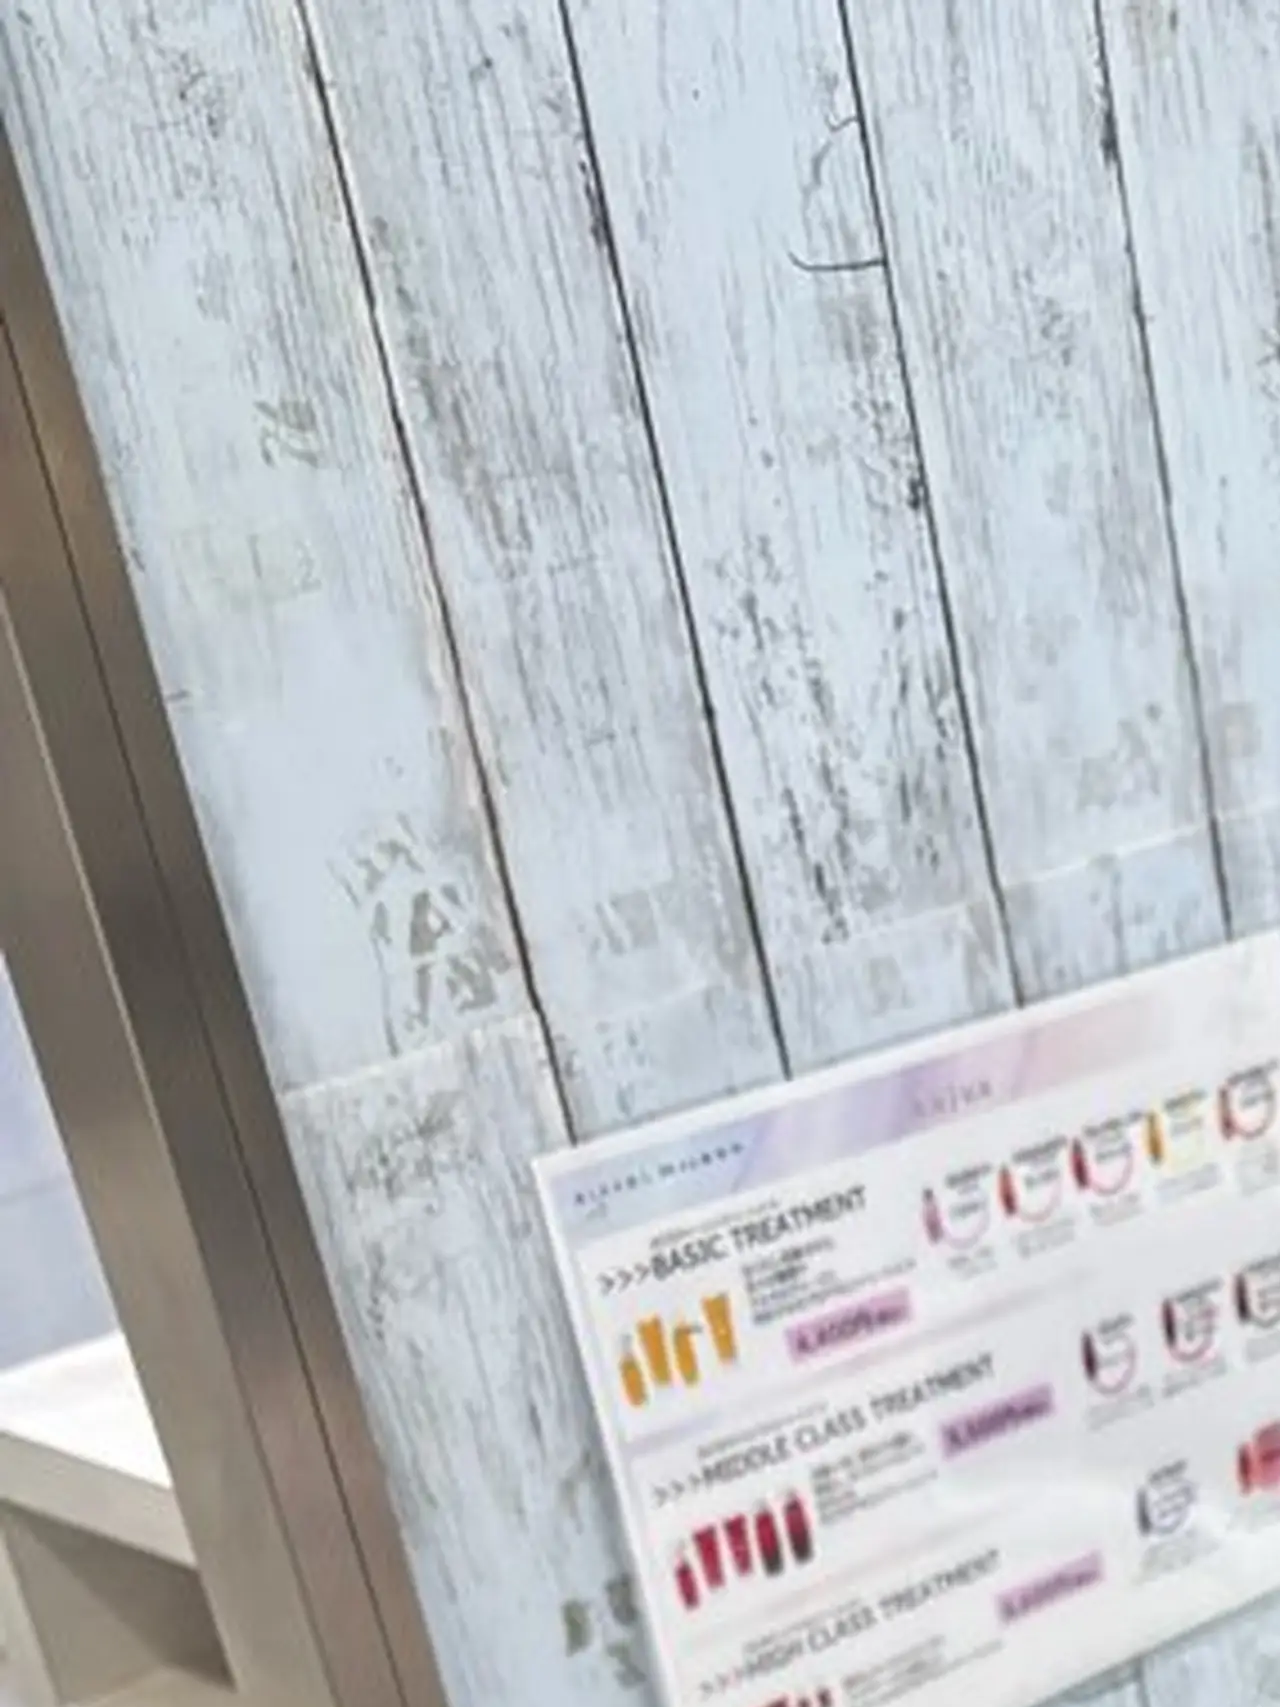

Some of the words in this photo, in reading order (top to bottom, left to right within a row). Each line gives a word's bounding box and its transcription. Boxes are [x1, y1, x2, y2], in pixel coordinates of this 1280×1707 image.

[651, 1235, 729, 1280] BASIC
[729, 1186, 867, 1254] TREATMENT
[701, 1438, 791, 1487] MIDDLE
[794, 1408, 867, 1454] CLASS
[870, 1353, 996, 1423] TREATMENT
[807, 1607, 878, 1654] CLASS
[879, 1549, 1000, 1620] TREATMENT
